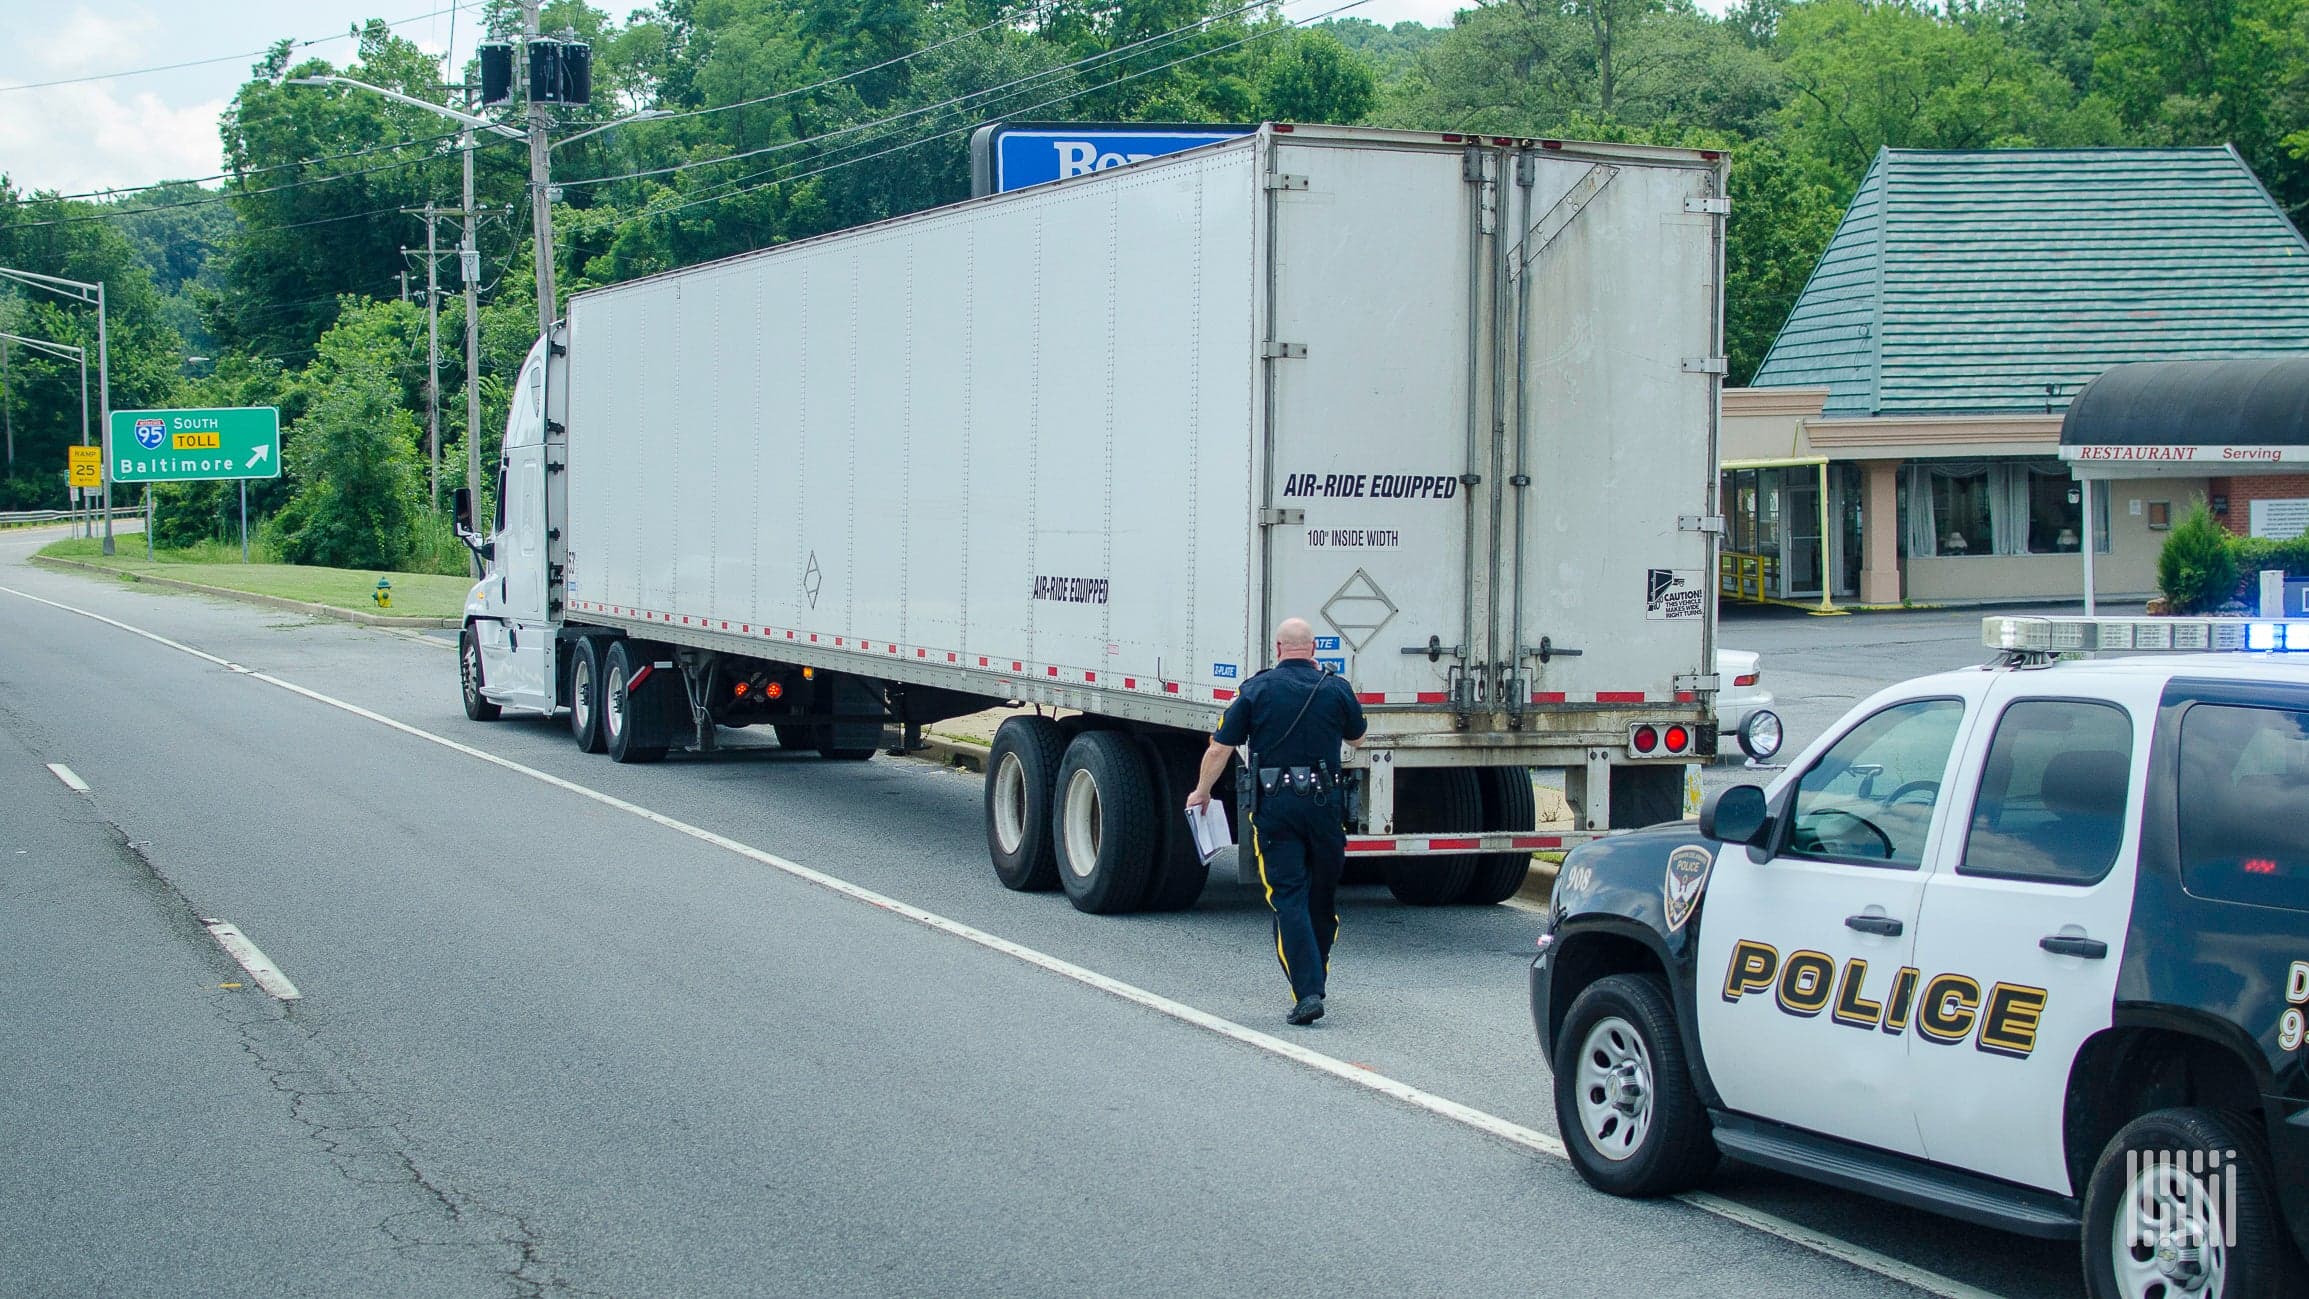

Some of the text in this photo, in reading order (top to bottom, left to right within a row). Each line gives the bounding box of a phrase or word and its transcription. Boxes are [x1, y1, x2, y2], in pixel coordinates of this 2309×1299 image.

[174, 417, 218, 429] SOUTH
[138, 426, 163, 444] 95
[177, 435, 216, 447] TOLL
[2080, 446, 2281, 462] RESTAURANT Serving
[76, 464, 95, 476] 25
[120, 458, 233, 474] Baltimore
[1284, 473, 1457, 499] AIR-RIDE EQUIPPED
[1331, 530, 1363, 547] INSIDE
[1366, 530, 1399, 547] WIDTH
[1033, 575, 1109, 604] AIR-RIDE EQUIPPED
[1664, 589, 1702, 601] CAUTION!
[1677, 860, 1700, 872] POLICE
[1566, 865, 1592, 892] 908
[1722, 938, 2048, 1060] POLICE
